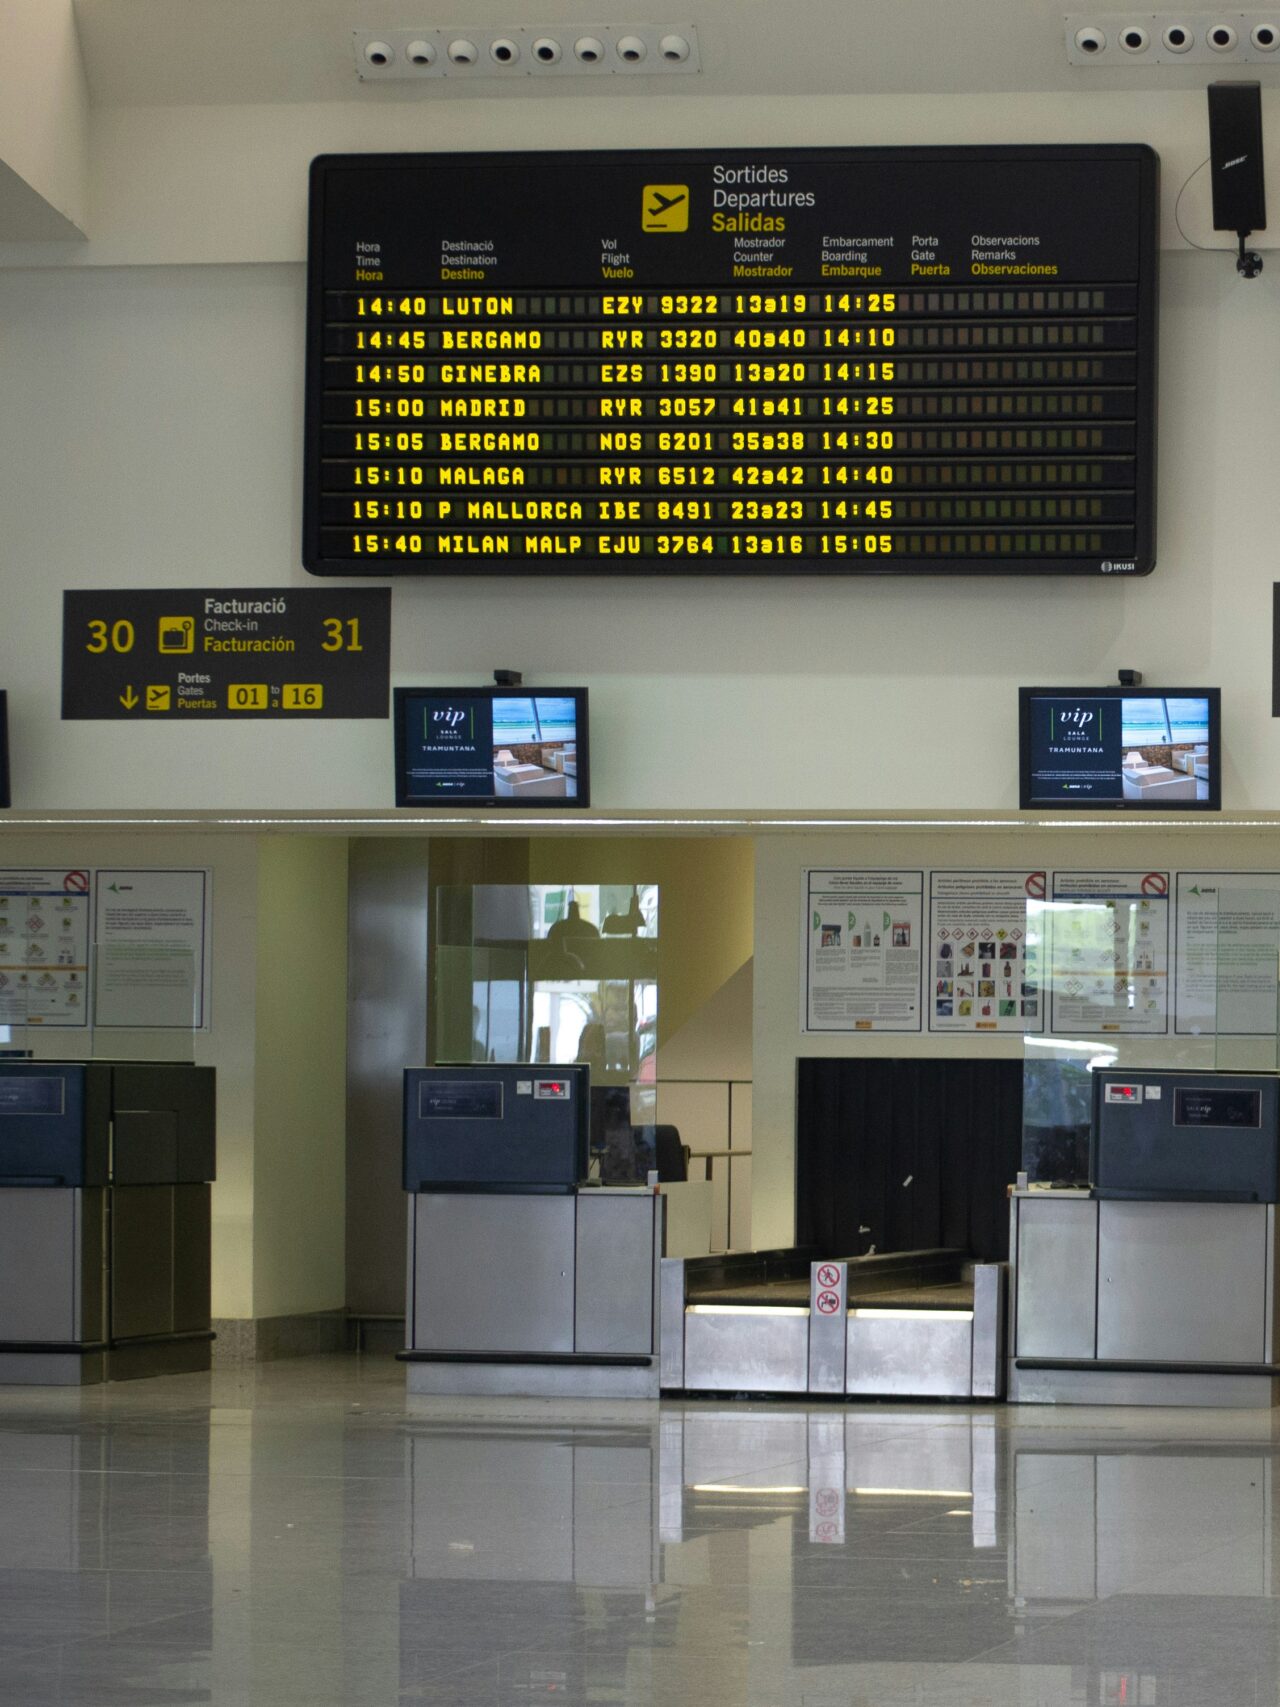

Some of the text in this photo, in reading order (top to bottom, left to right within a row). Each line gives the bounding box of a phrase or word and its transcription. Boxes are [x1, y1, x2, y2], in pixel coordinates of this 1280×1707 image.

[714, 165, 788, 183] Sortides
[714, 190, 815, 211] Departures
[712, 213, 785, 231] Salidas
[442, 241, 494, 251] Destinació
[602, 240, 616, 249] Vol
[735, 237, 785, 248] Mostrador
[823, 237, 893, 247] Embarcament
[912, 236, 938, 246] Porta
[972, 235, 1040, 246] Observacions
[357, 242, 380, 252] Hora
[442, 255, 497, 265] Destination
[602, 253, 629, 266] Flight
[734, 252, 773, 262] Counter
[822, 251, 867, 263] Boarding
[911, 250, 935, 260] Gate
[972, 250, 1016, 260] Remarks
[356, 256, 380, 266] Time
[442, 268, 484, 279] Destino
[602, 267, 633, 278] Vuelo
[734, 265, 792, 276] Mostrador
[822, 265, 881, 278] Embarque
[912, 264, 950, 275] Puerta
[972, 263, 1057, 275] Observaciones
[356, 270, 383, 280] Hora
[359, 294, 895, 315] 14:40 LUTON EZY 9322 13a19 14:25
[358, 329, 894, 348] 14:45 BERGAMO RYR 3320 40a40 14:10
[354, 501, 891, 519] 15:10 P MALLORCA IBE 8491 23a23 14:45
[354, 535, 891, 553] 15:40 MILAN MALP EJU 3764 13a16 15:05
[205, 598, 286, 613] Facturació
[204, 619, 258, 631] Check-in
[87, 620, 134, 653] 30
[322, 618, 362, 651] 31
[204, 636, 294, 651] Facturación
[178, 673, 210, 683] Portes
[177, 686, 204, 695] Gates
[271, 686, 280, 694] to
[236, 688, 259, 705] 01
[293, 688, 315, 705] 16
[178, 698, 217, 708] Puertas
[433, 707, 465, 726] vip
[1060, 708, 1094, 727] vip
